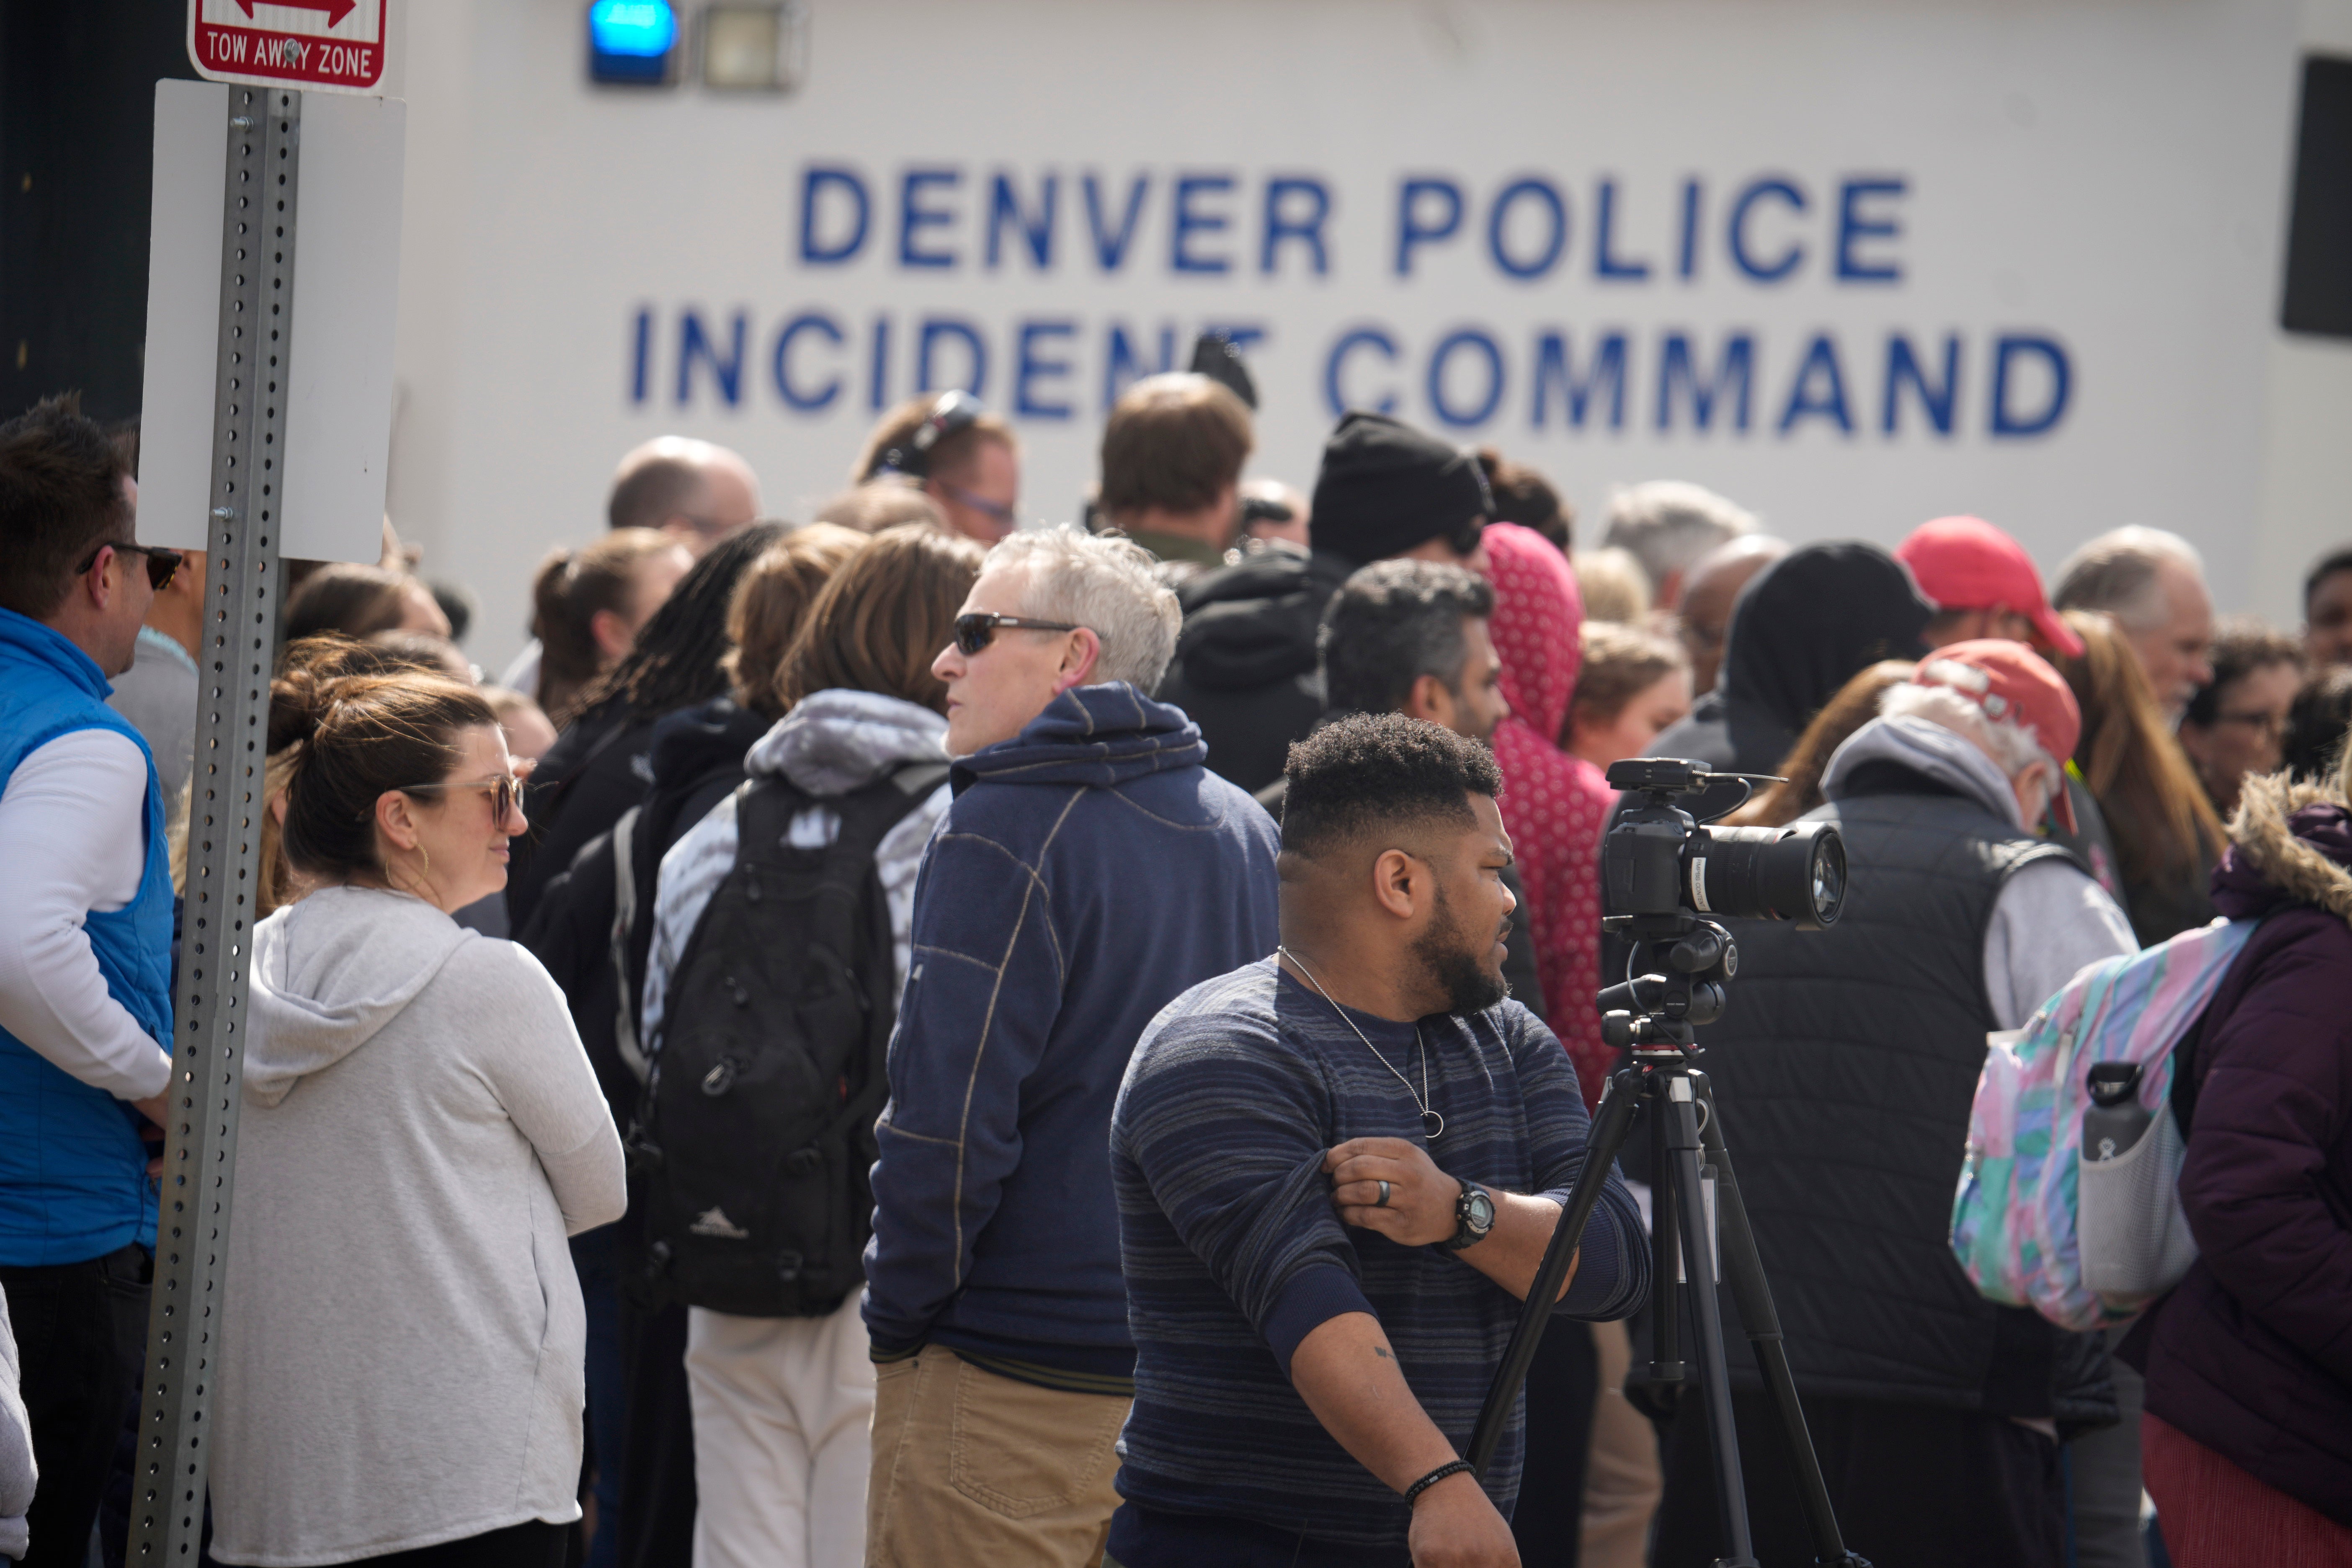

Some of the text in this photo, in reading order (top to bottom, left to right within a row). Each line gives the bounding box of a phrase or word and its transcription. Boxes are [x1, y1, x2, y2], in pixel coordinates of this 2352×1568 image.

[208, 31, 372, 78] TOW AWY ZONE
[798, 168, 1906, 283] DENVER POLICE
[1321, 328, 2072, 438] COMMAND
[1695, 882, 1706, 907] CONTENT
